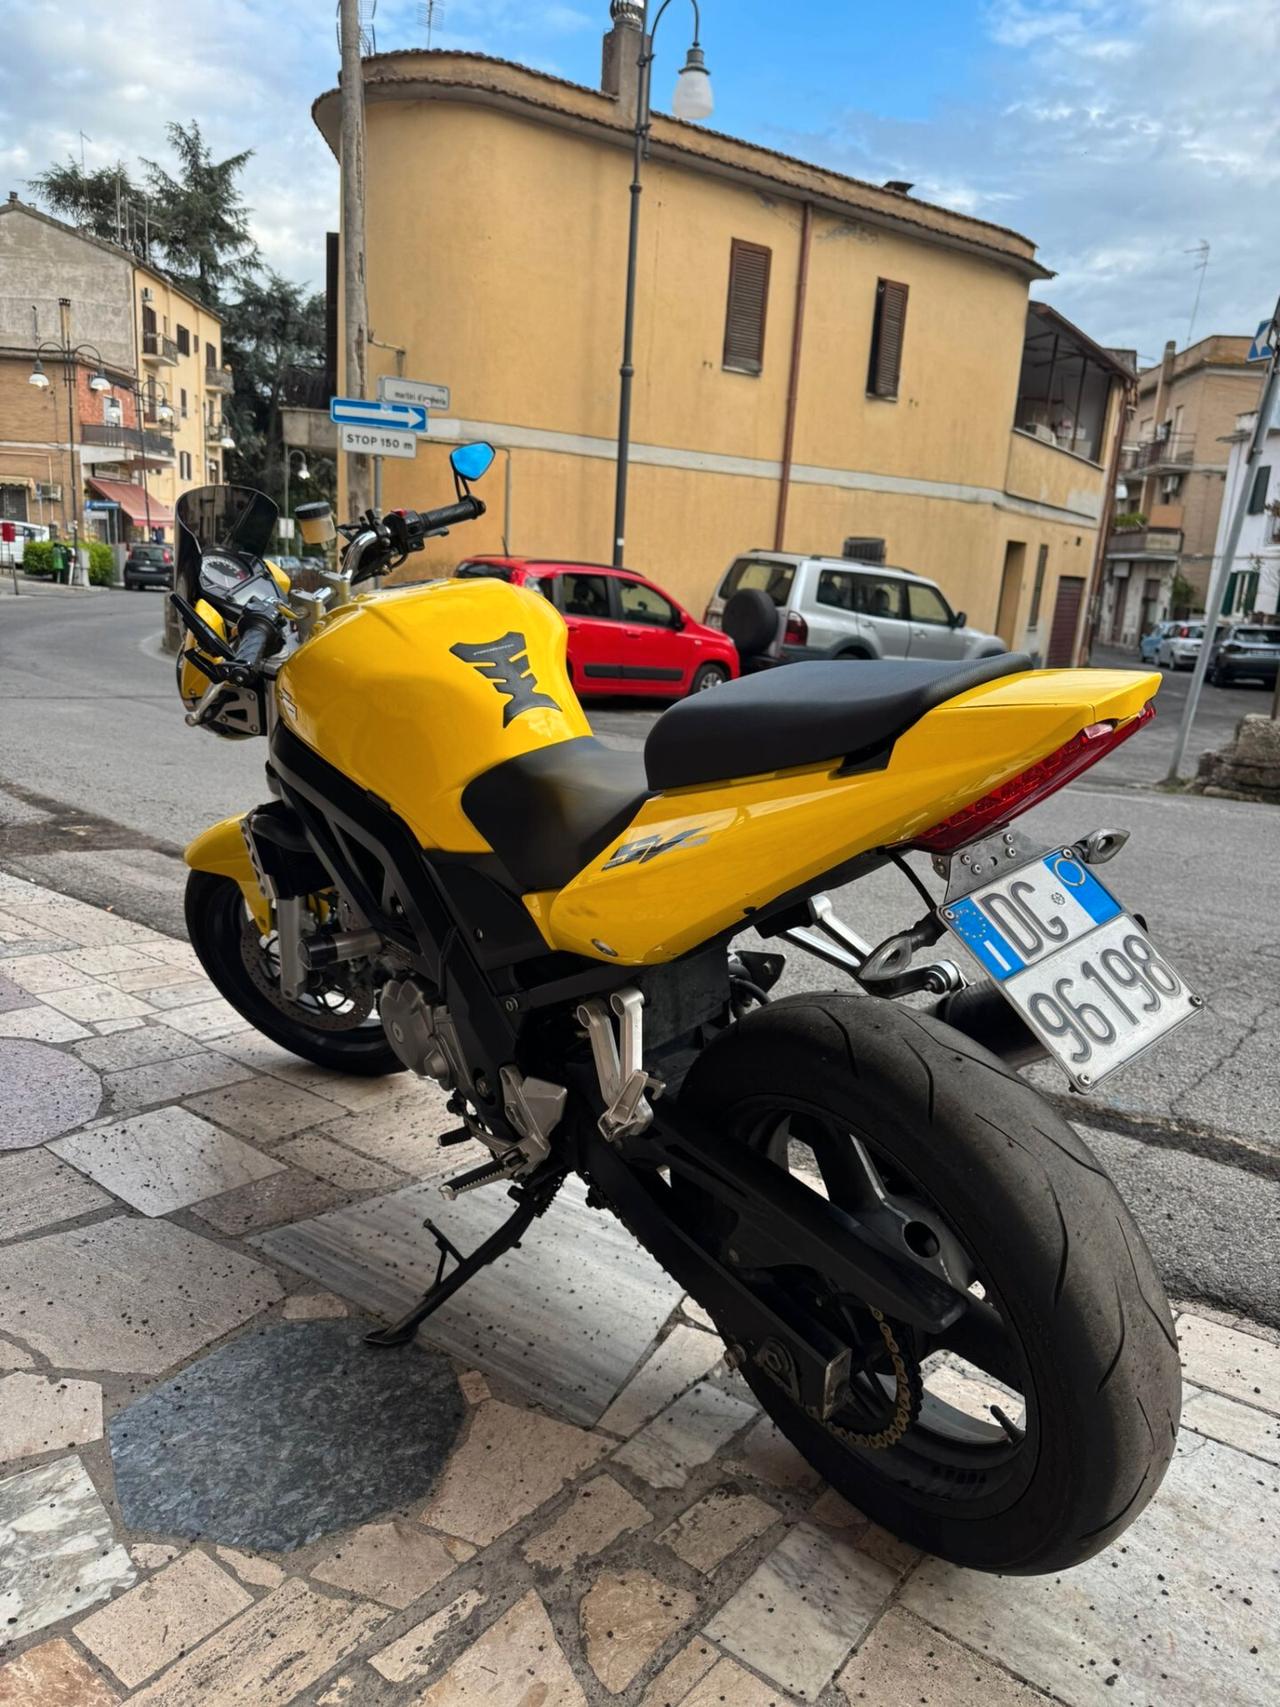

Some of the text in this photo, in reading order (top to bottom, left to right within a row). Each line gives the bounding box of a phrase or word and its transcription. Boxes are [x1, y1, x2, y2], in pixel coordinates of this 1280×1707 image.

[347, 434, 413, 450] STOP 150 m
[978, 880, 1070, 959] DG
[1027, 934, 1182, 1064] 96198
